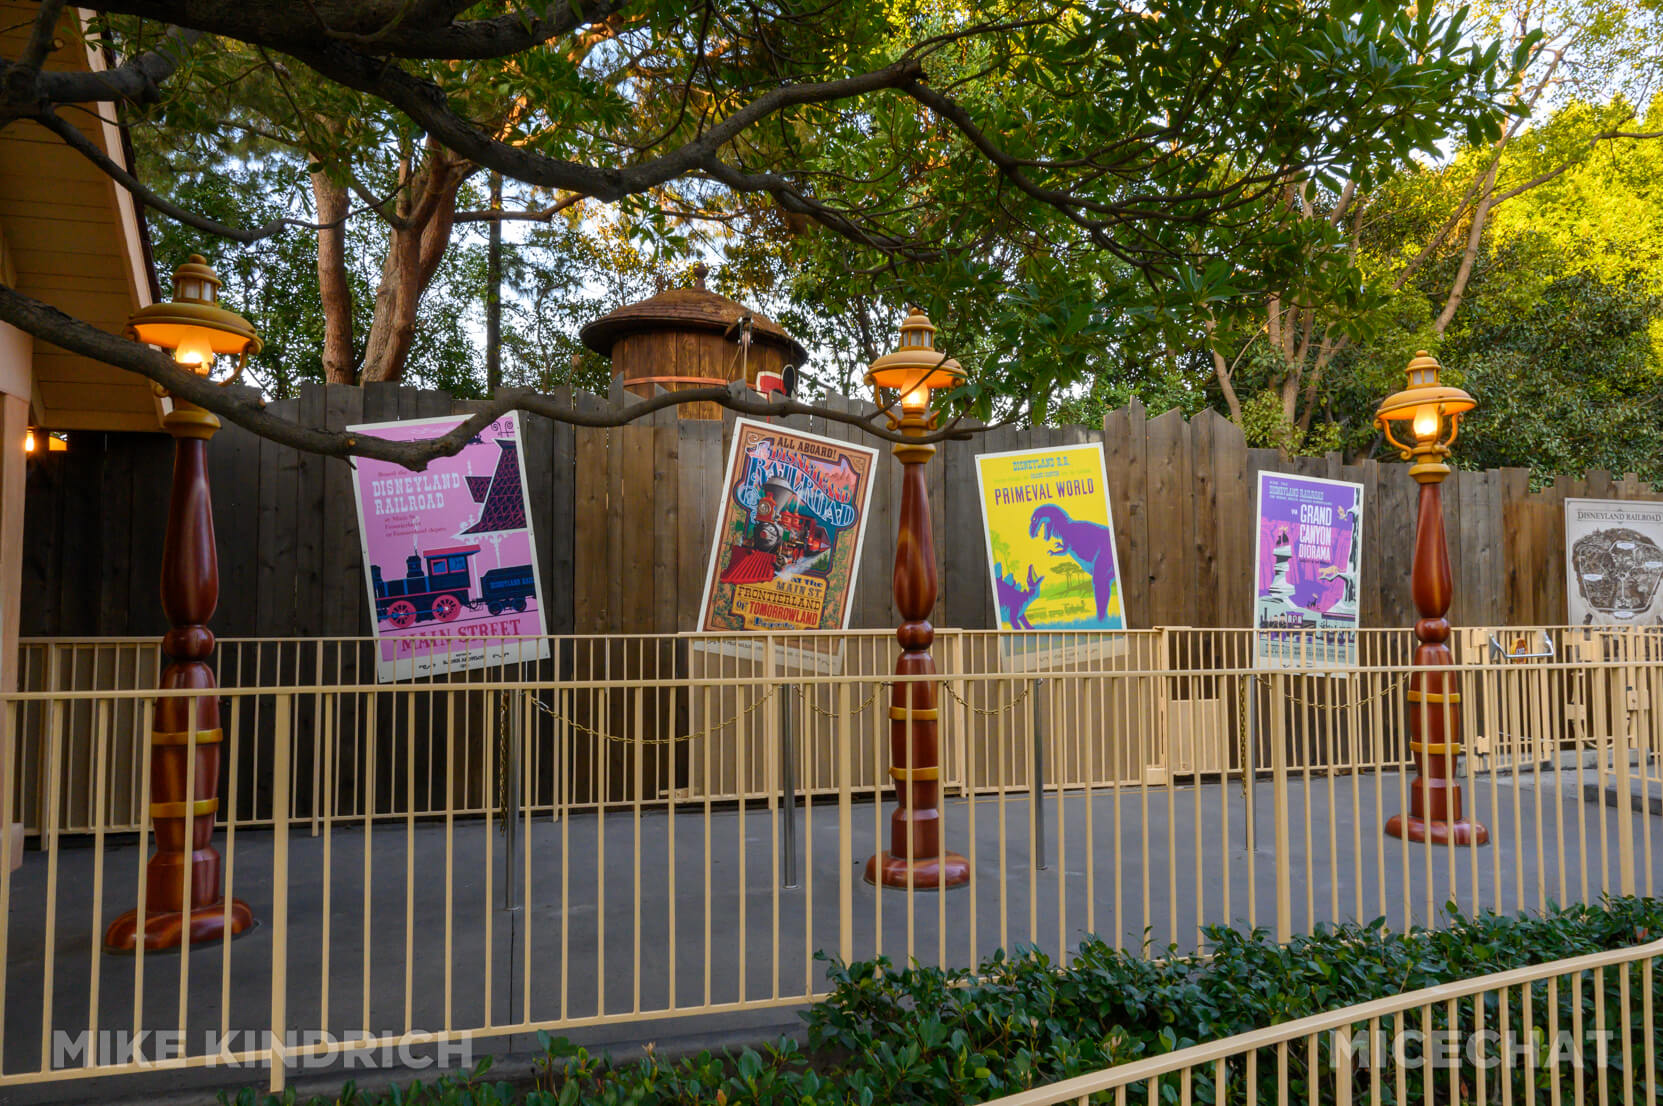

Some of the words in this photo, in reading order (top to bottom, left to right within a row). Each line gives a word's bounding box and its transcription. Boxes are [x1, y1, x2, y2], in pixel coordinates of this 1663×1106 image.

[777, 437, 795, 450] ALL
[797, 441, 837, 459] ABOARD!
[371, 472, 460, 497] DISNEYLAND
[745, 456, 857, 527] RAILROAD
[994, 483, 1053, 506] PRIMEVAL
[1056, 478, 1095, 498] WORLD
[374, 491, 445, 515] RAILROAD
[1300, 503, 1333, 526] GRAND
[1577, 511, 1625, 520] DISNEYLAND
[1626, 512, 1662, 522] RAILROAD
[1299, 524, 1332, 546] CANYON
[1298, 543, 1331, 561] DIORAMA
[737, 586, 821, 610] FRONTIERLAND
[776, 581, 807, 595] MAIN
[749, 600, 819, 626] TOMORROWLAND
[401, 628, 451, 652] MAIN
[457, 619, 521, 644] STREET
